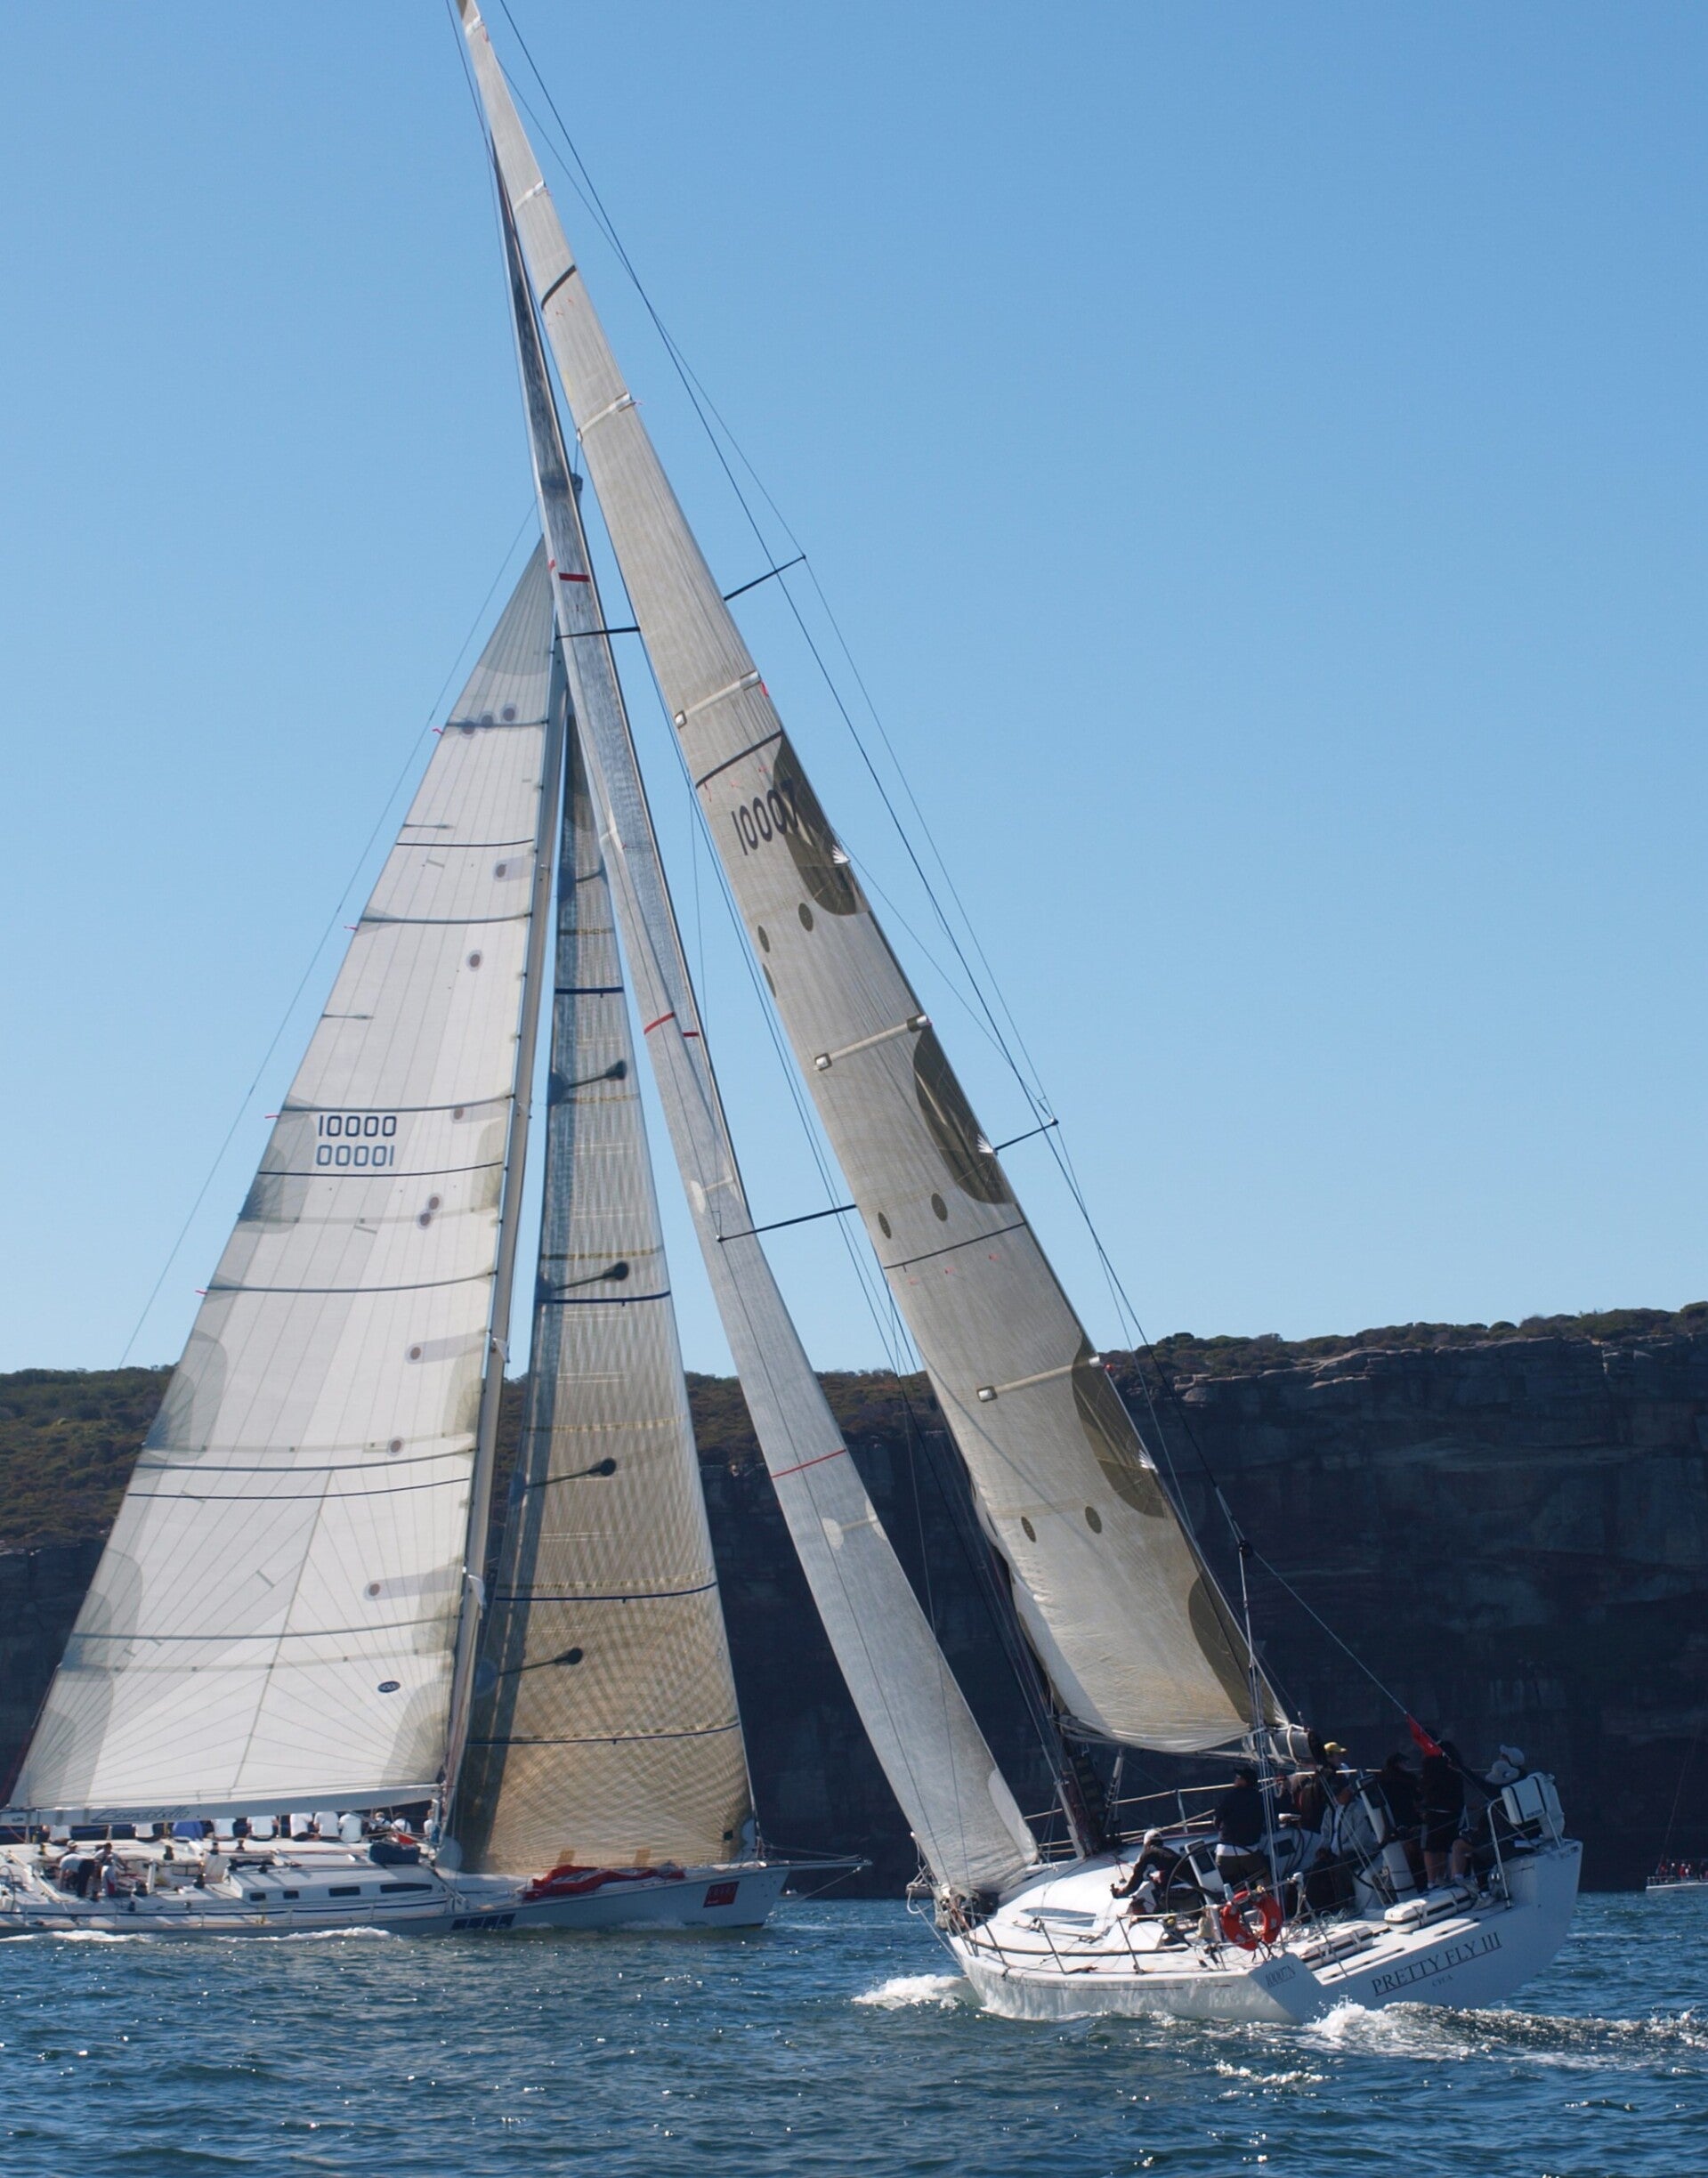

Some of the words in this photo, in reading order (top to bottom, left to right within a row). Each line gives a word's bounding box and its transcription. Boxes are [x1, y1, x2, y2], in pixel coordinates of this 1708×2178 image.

[318, 1114, 397, 1138] 10000
[1372, 1954, 1440, 1995] PRETTY
[1445, 1940, 1476, 1966] FLY
[1481, 1931, 1501, 1952] III
